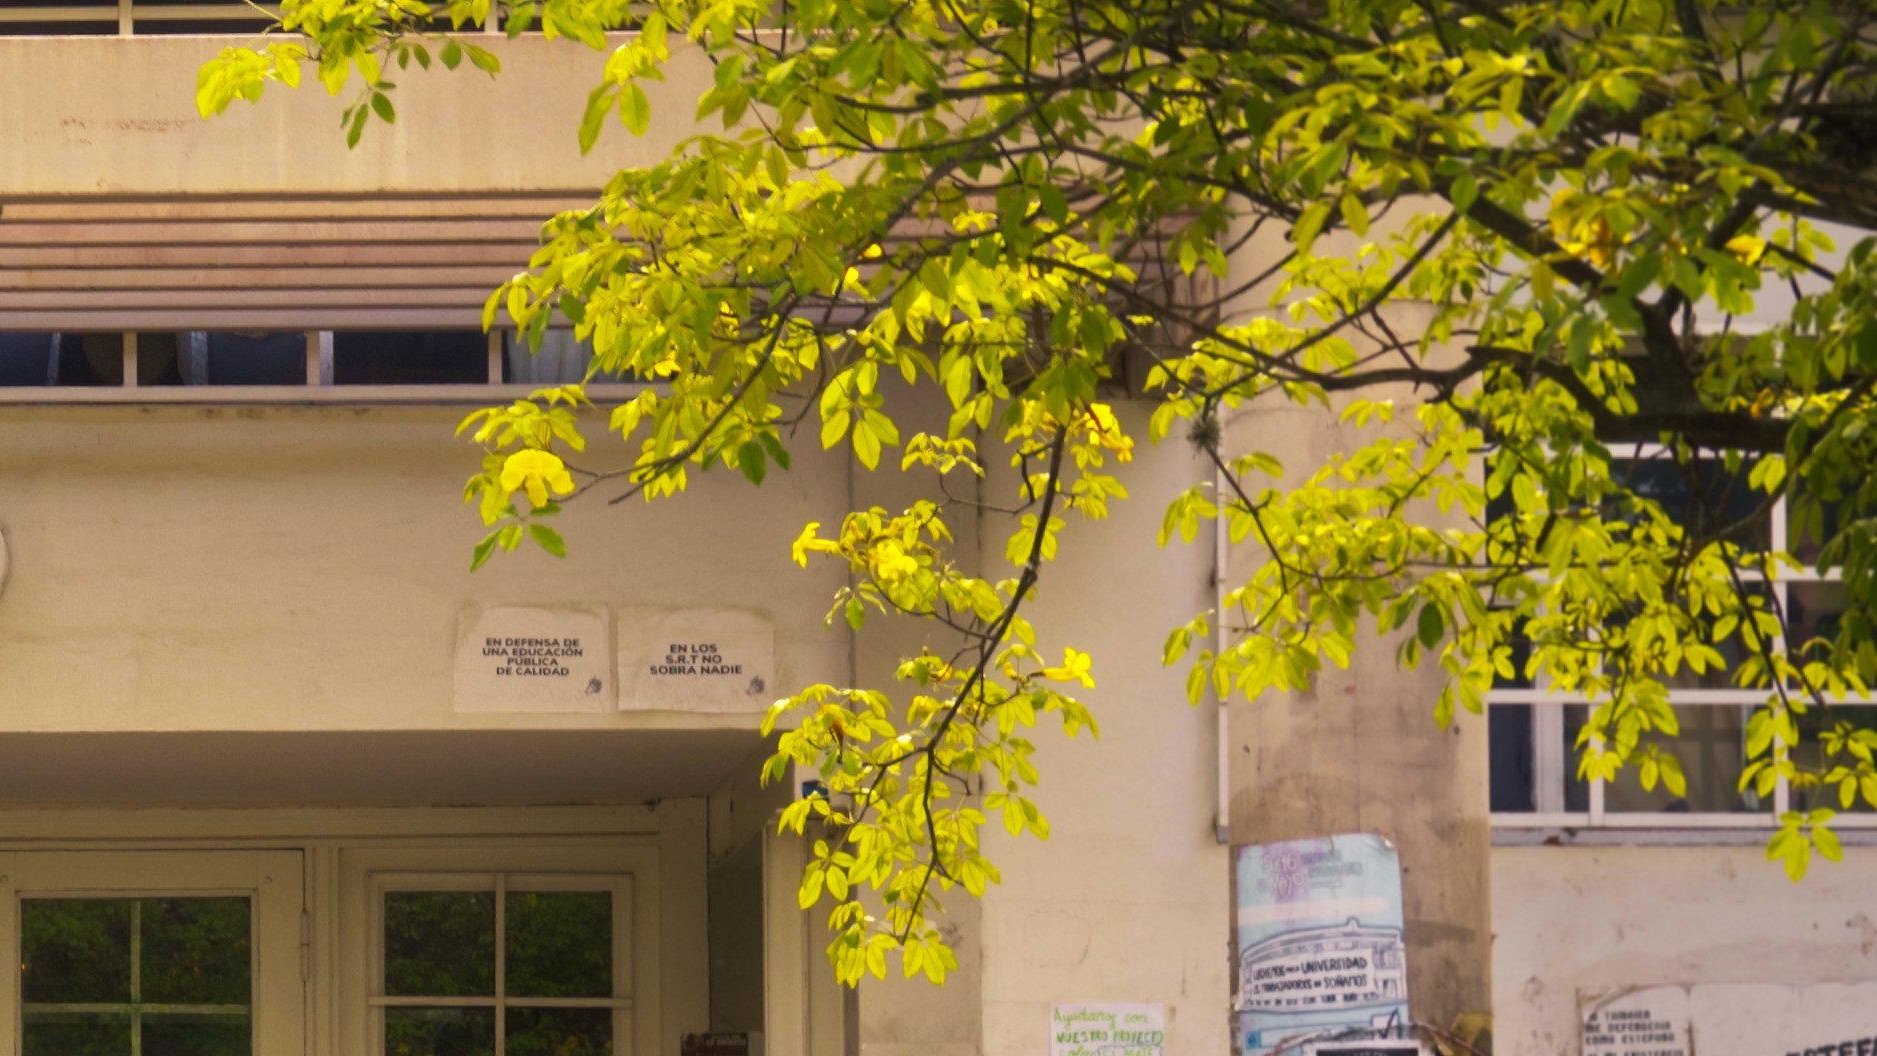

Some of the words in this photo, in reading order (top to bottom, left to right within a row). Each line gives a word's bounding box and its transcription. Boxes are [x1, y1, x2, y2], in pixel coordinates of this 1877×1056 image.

[486, 637, 502, 647] EN
[505, 637, 560, 647] DEFENSA
[563, 638, 580, 648] DE
[482, 648, 509, 656] UNA
[670, 644, 688, 653] EN
[691, 643, 718, 653] LOS
[702, 655, 723, 664] NO
[495, 667, 513, 676] DE
[515, 667, 571, 676] CALIDAD
[650, 665, 697, 675] SOBRA
[700, 665, 743, 675] NADIE
